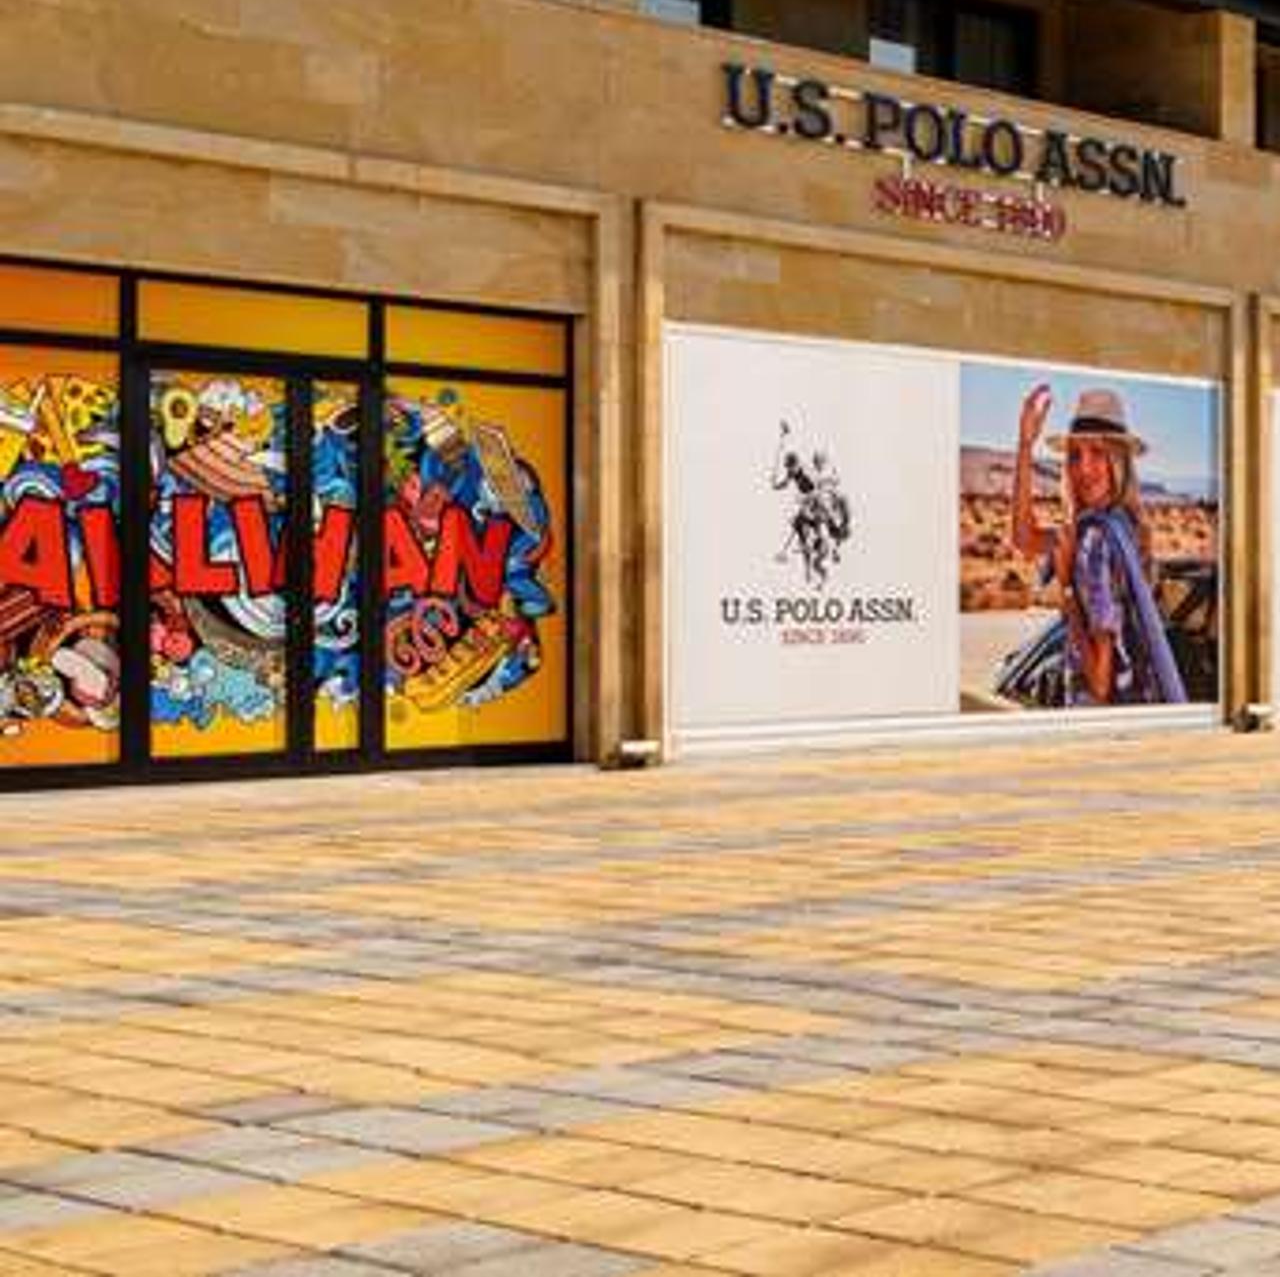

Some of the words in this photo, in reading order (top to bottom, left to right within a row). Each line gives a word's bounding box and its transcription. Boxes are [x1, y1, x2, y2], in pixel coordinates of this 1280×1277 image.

[720, 62, 845, 143] U.S.
[860, 91, 1023, 176] POLO
[1036, 128, 1187, 208] ASSN.
[721, 597, 766, 625] U.S.
[773, 597, 844, 624] POLO
[848, 596, 919, 624] ASSN.
